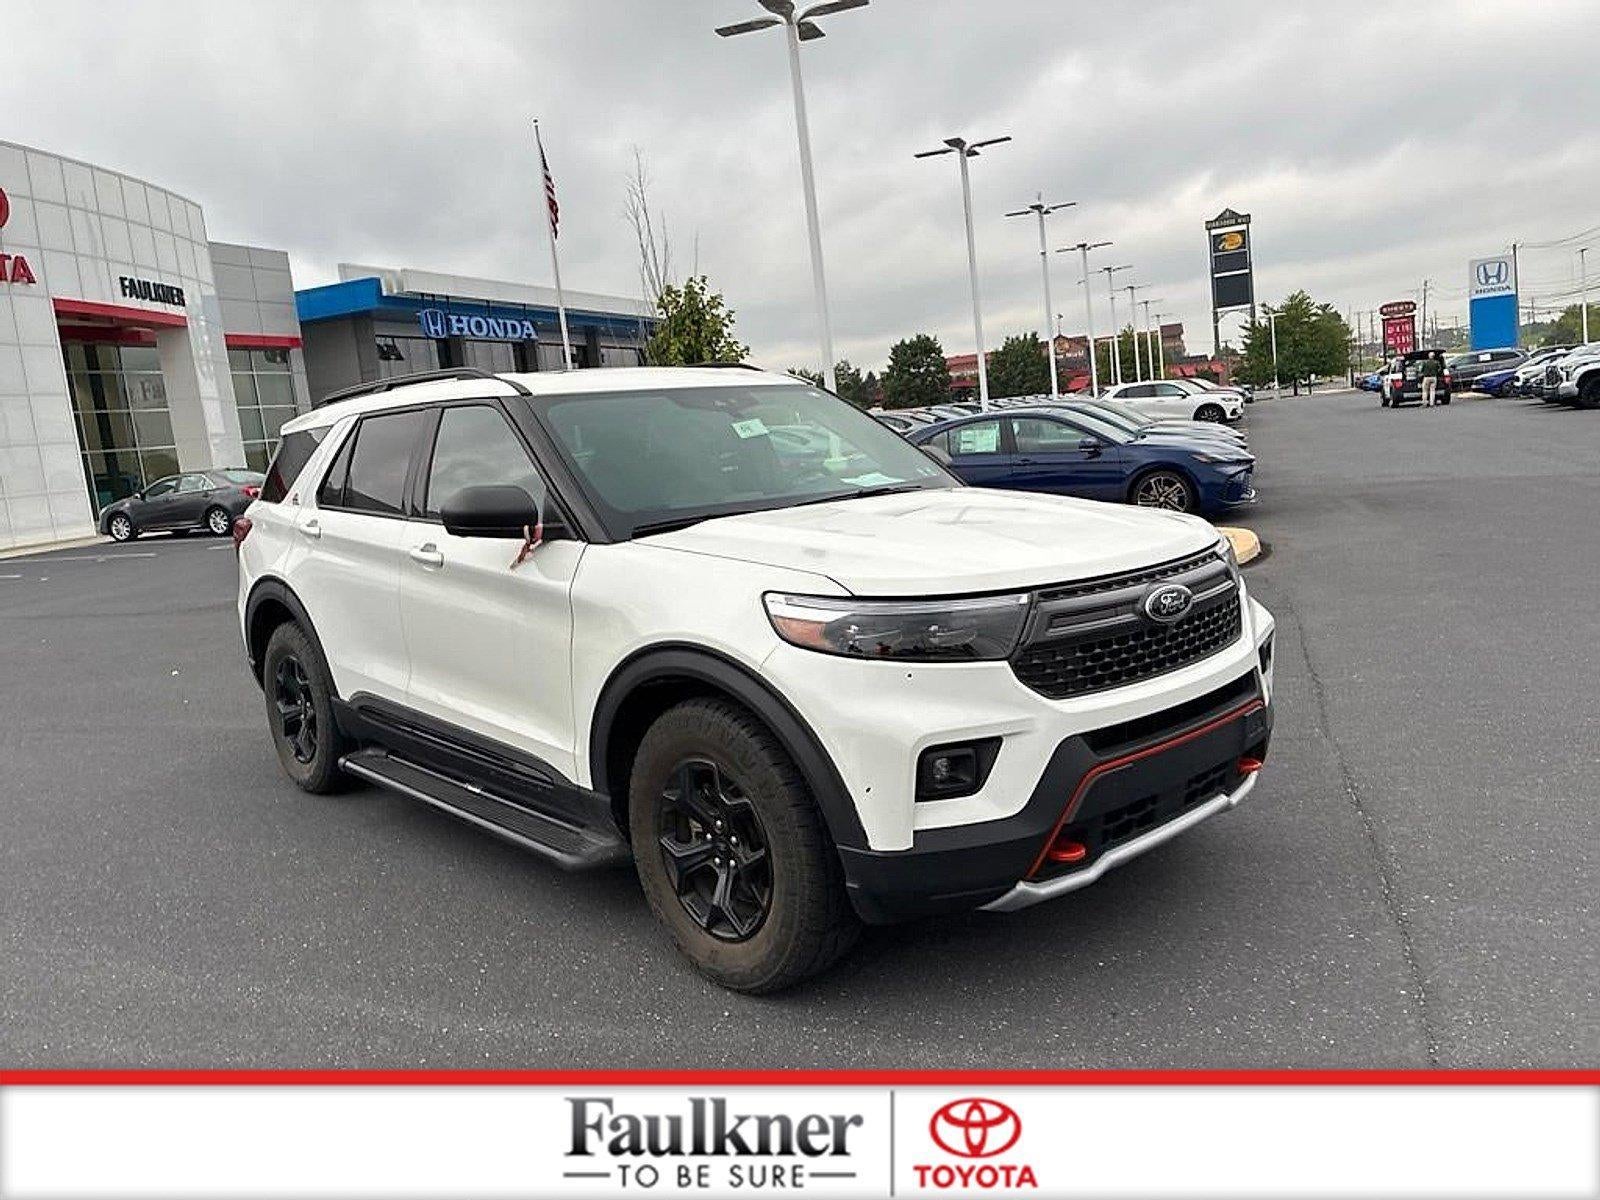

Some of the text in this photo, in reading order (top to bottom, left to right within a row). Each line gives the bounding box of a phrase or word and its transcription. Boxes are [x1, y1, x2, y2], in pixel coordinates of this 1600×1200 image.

[119, 276, 186, 307] FAULKNER
[1475, 285, 1511, 294] HONDA
[449, 315, 538, 339] HONDA
